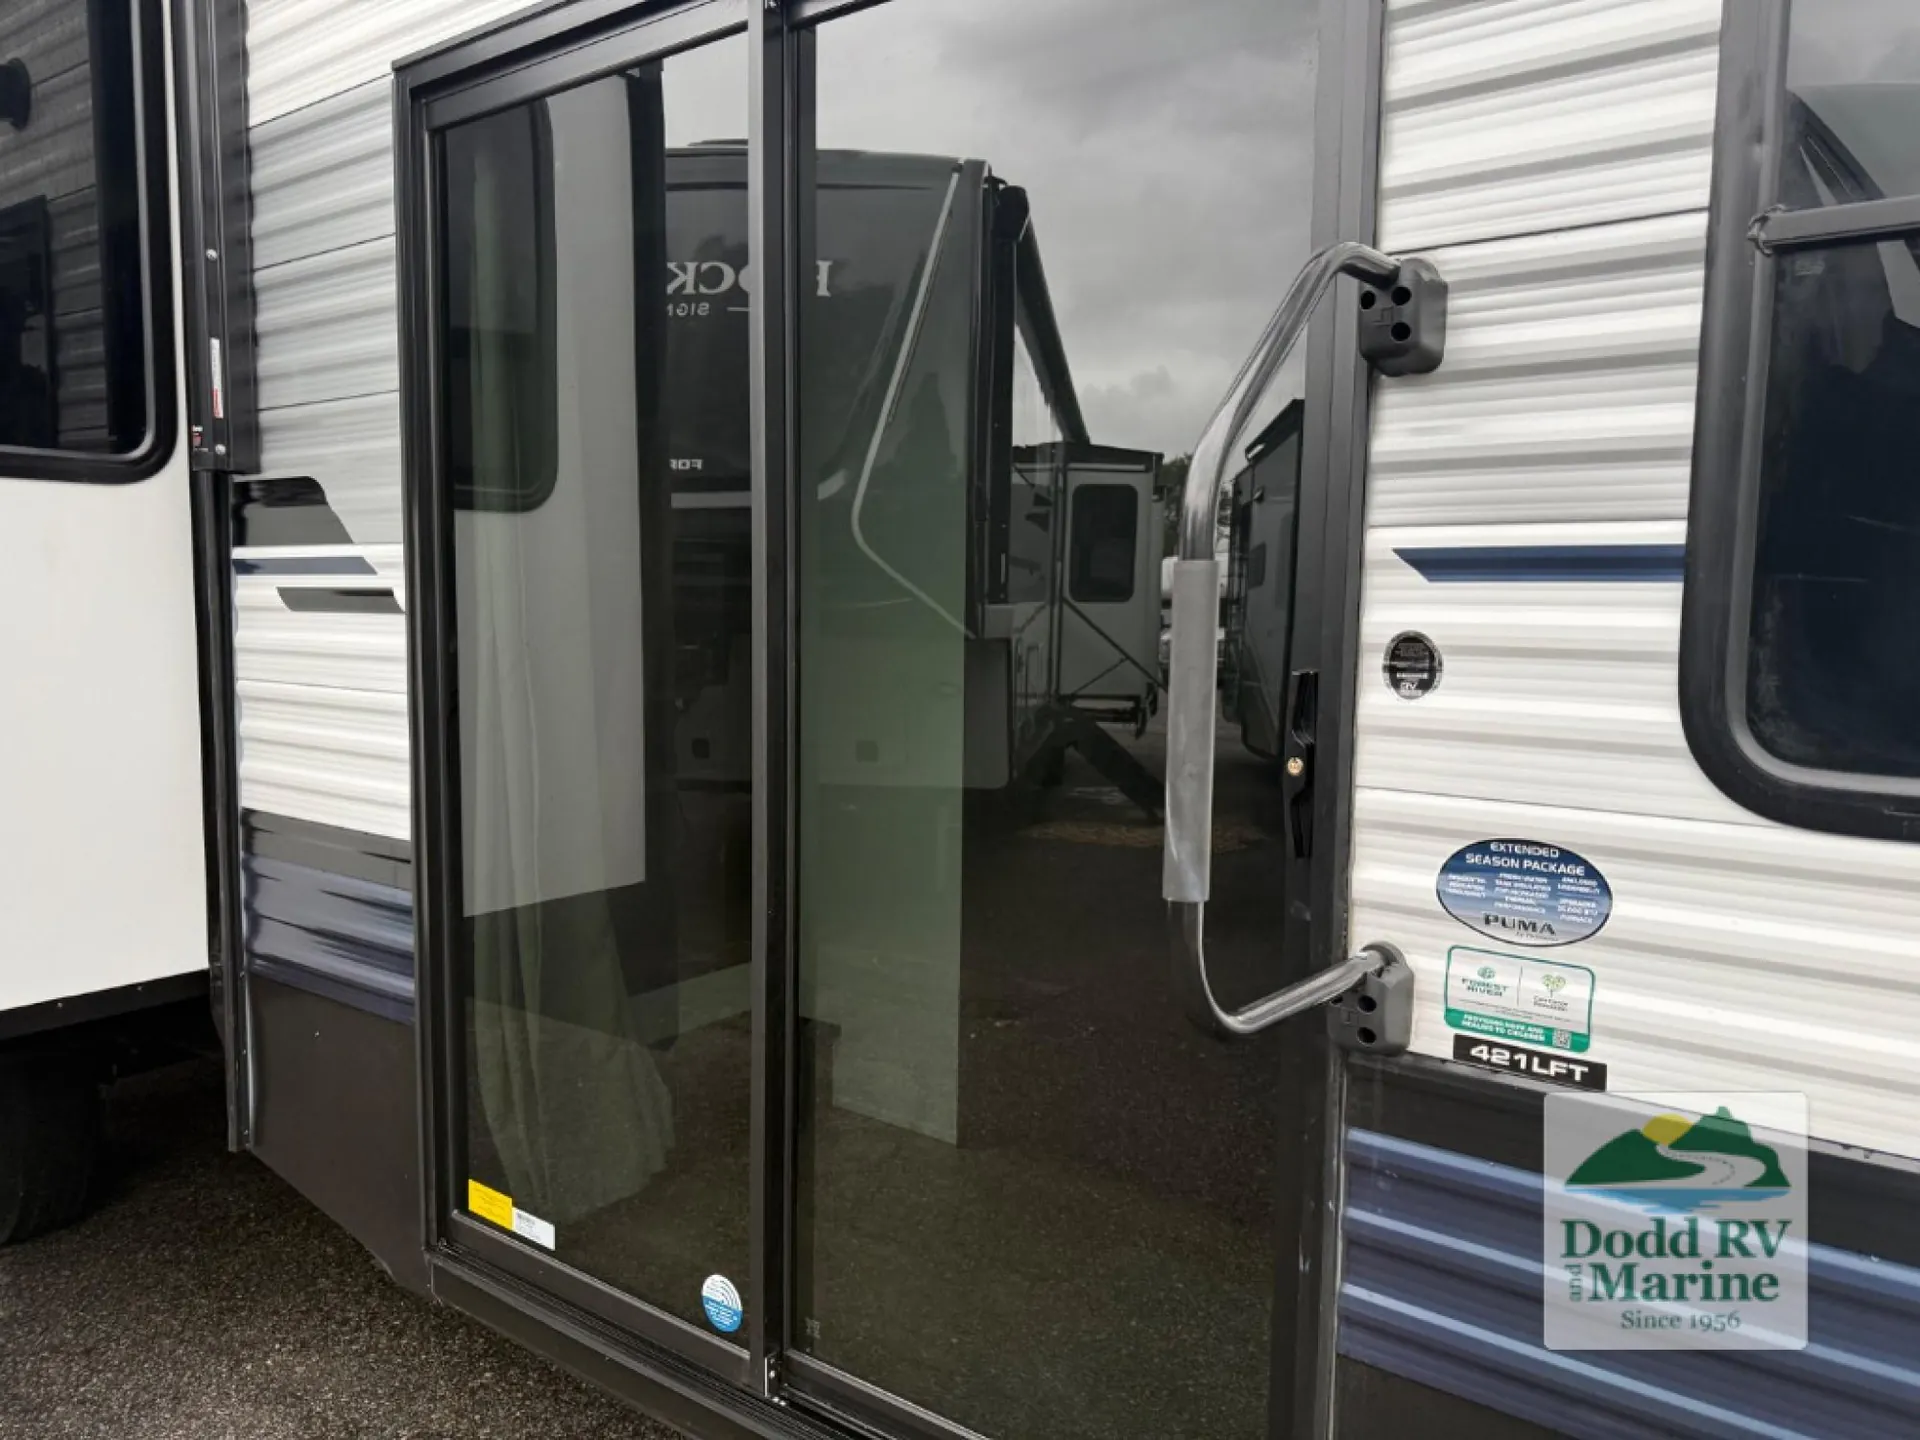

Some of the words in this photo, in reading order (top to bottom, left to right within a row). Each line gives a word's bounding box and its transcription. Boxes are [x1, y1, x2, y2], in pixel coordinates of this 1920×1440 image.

[1490, 842, 1559, 858] EXTENDED
[1465, 852, 1520, 869] SEASON
[1523, 859, 1585, 877] PACKAGE
[1483, 913, 1557, 936] PUMA
[1469, 1043, 1589, 1081] 421LFT
